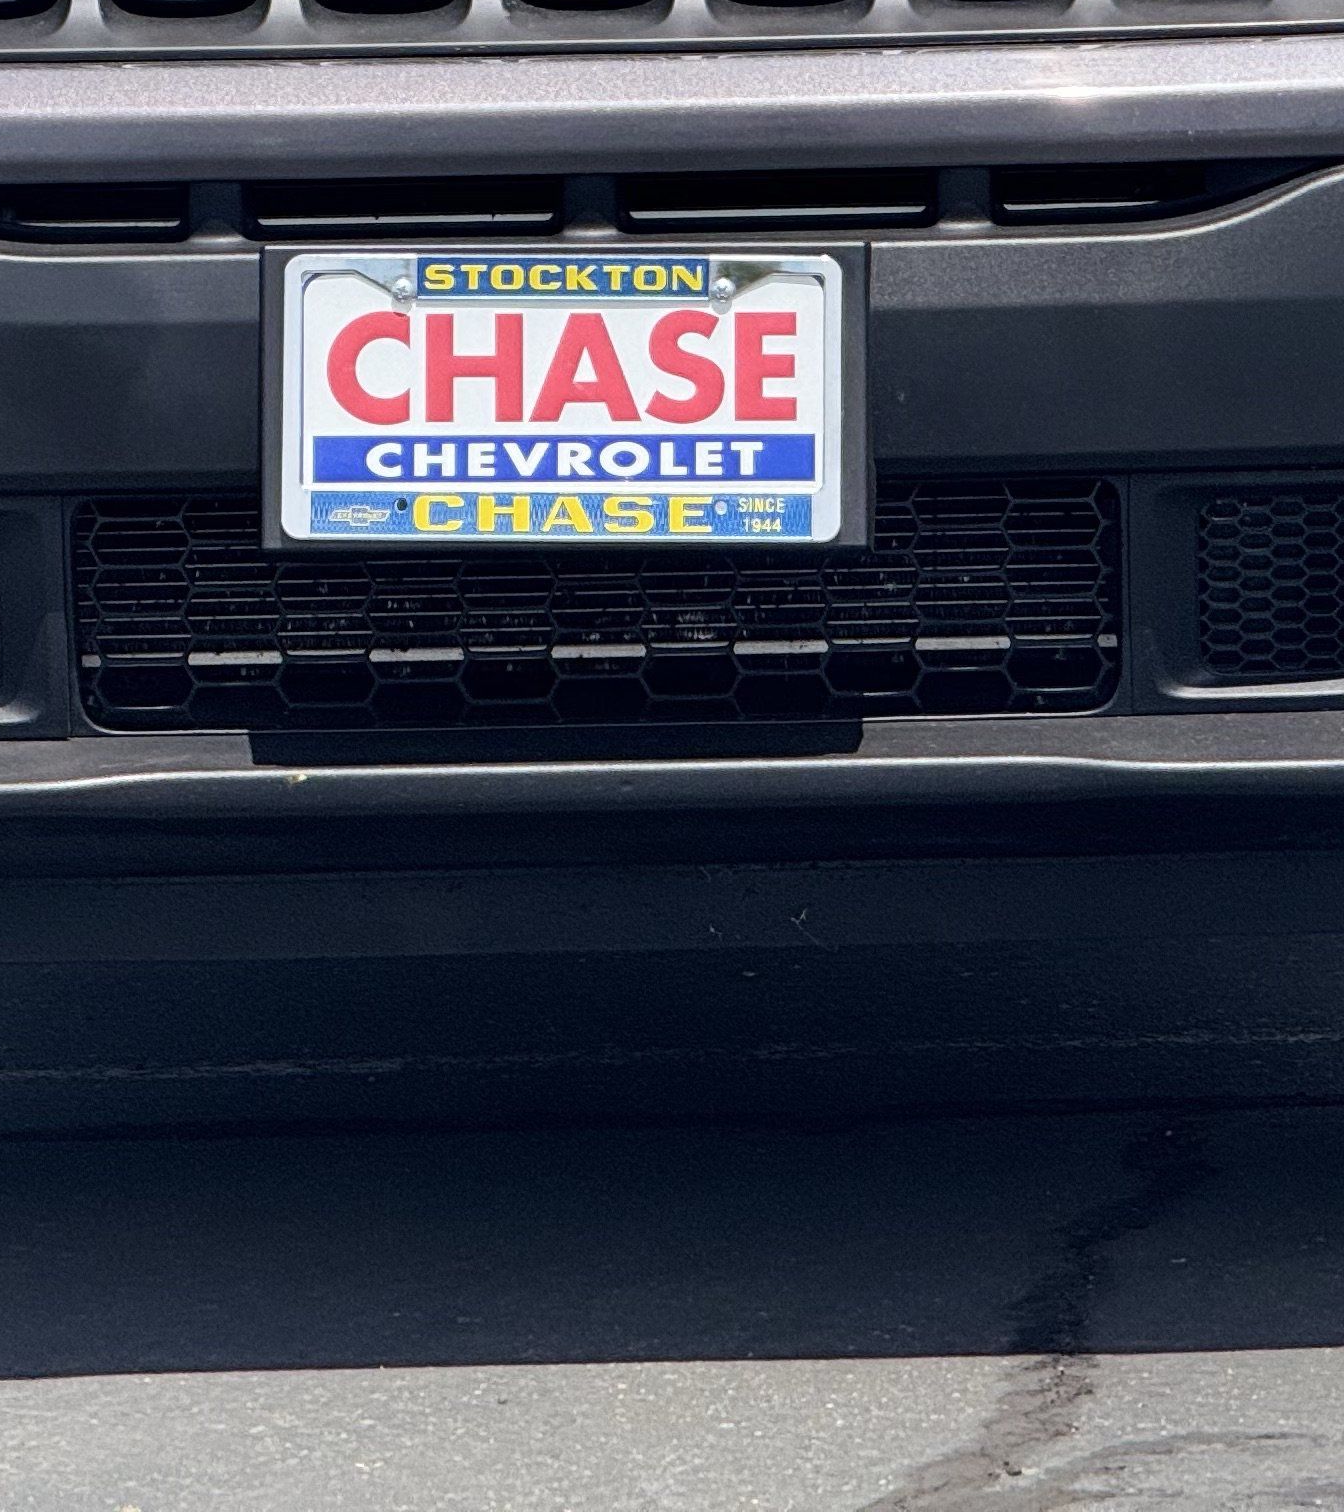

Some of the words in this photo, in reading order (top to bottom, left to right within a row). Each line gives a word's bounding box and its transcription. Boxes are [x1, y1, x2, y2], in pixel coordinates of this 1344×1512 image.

[424, 265, 703, 291] STOCKTON
[327, 310, 797, 425] CHASE
[366, 442, 763, 478] CHEVROLET
[412, 495, 713, 533] CHASE
[738, 497, 785, 513] SINCE
[743, 517, 782, 533] 1944
